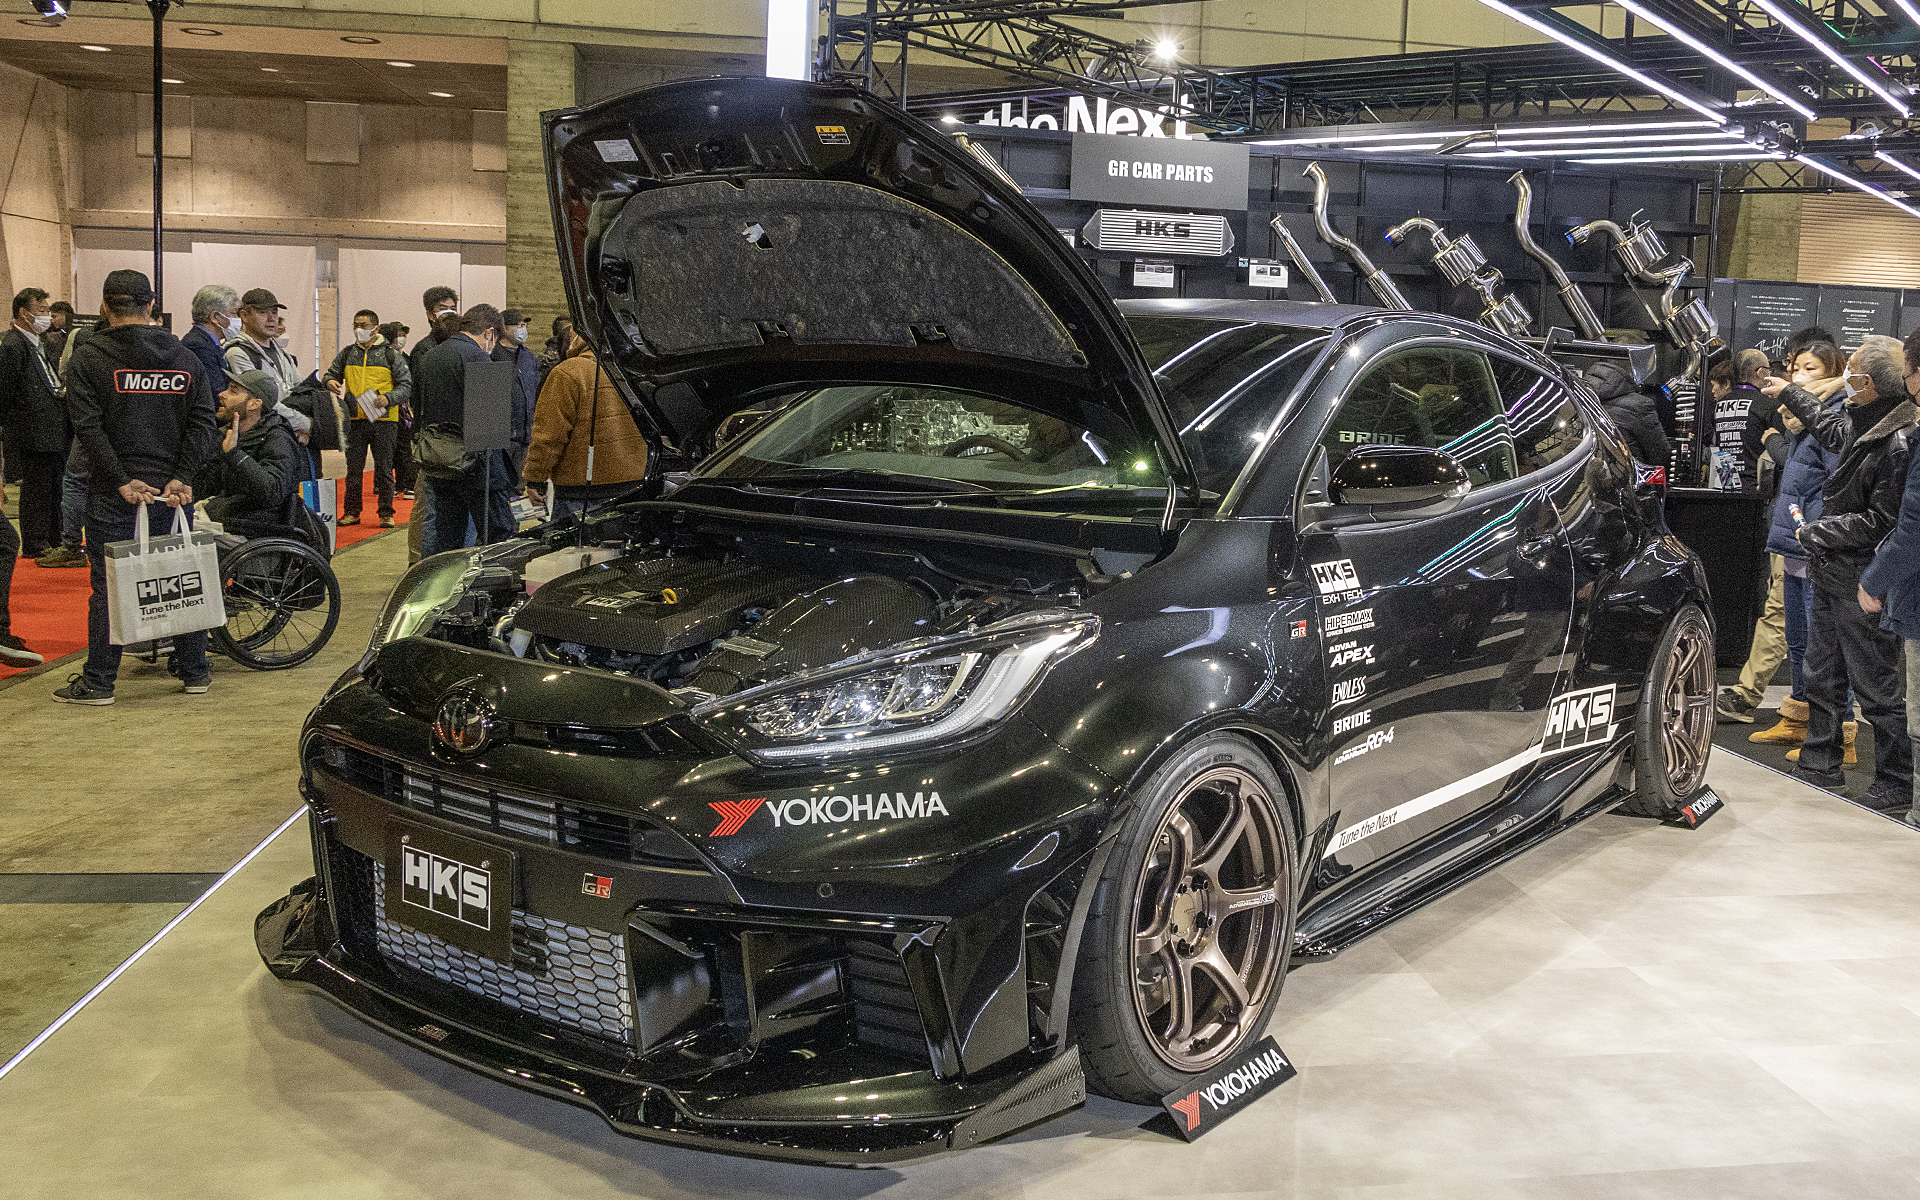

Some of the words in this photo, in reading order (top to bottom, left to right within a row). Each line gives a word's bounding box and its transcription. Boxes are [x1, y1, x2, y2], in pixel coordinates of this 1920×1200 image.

[1068, 93, 1195, 140] Next
[1108, 160, 1129, 178] GR
[1132, 161, 1162, 180] CAR
[1166, 164, 1214, 184] PARTS
[1135, 219, 1191, 238] HKS
[123, 373, 186, 391] MoTeC
[1715, 400, 1752, 415] HKS
[1339, 430, 1406, 446] BRIDE
[1313, 561, 1356, 586] HKS
[138, 572, 202, 602] HKS
[1323, 594, 1340, 605] EXH
[1341, 589, 1364, 601] TECH
[140, 606, 164, 616] Tune
[164, 602, 181, 612] the
[182, 598, 205, 608] Next
[1290, 624, 1306, 638] GR
[1325, 608, 1373, 631] HIPERMAX
[1329, 640, 1357, 653] ADVAN
[1330, 644, 1374, 668] APEX
[1331, 675, 1367, 705] ENDLESS
[1333, 709, 1372, 735] BRIDE
[1544, 690, 1613, 740] HKS
[1365, 726, 1395, 751] RG-4
[765, 791, 950, 828] YOKOHAMA
[1338, 829, 1360, 849] Tune
[1360, 821, 1375, 838] the
[1375, 810, 1398, 831] Next
[404, 851, 488, 910] HKS
[582, 879, 611, 897] GR
[1199, 1048, 1289, 1111] YOKOHAMA
